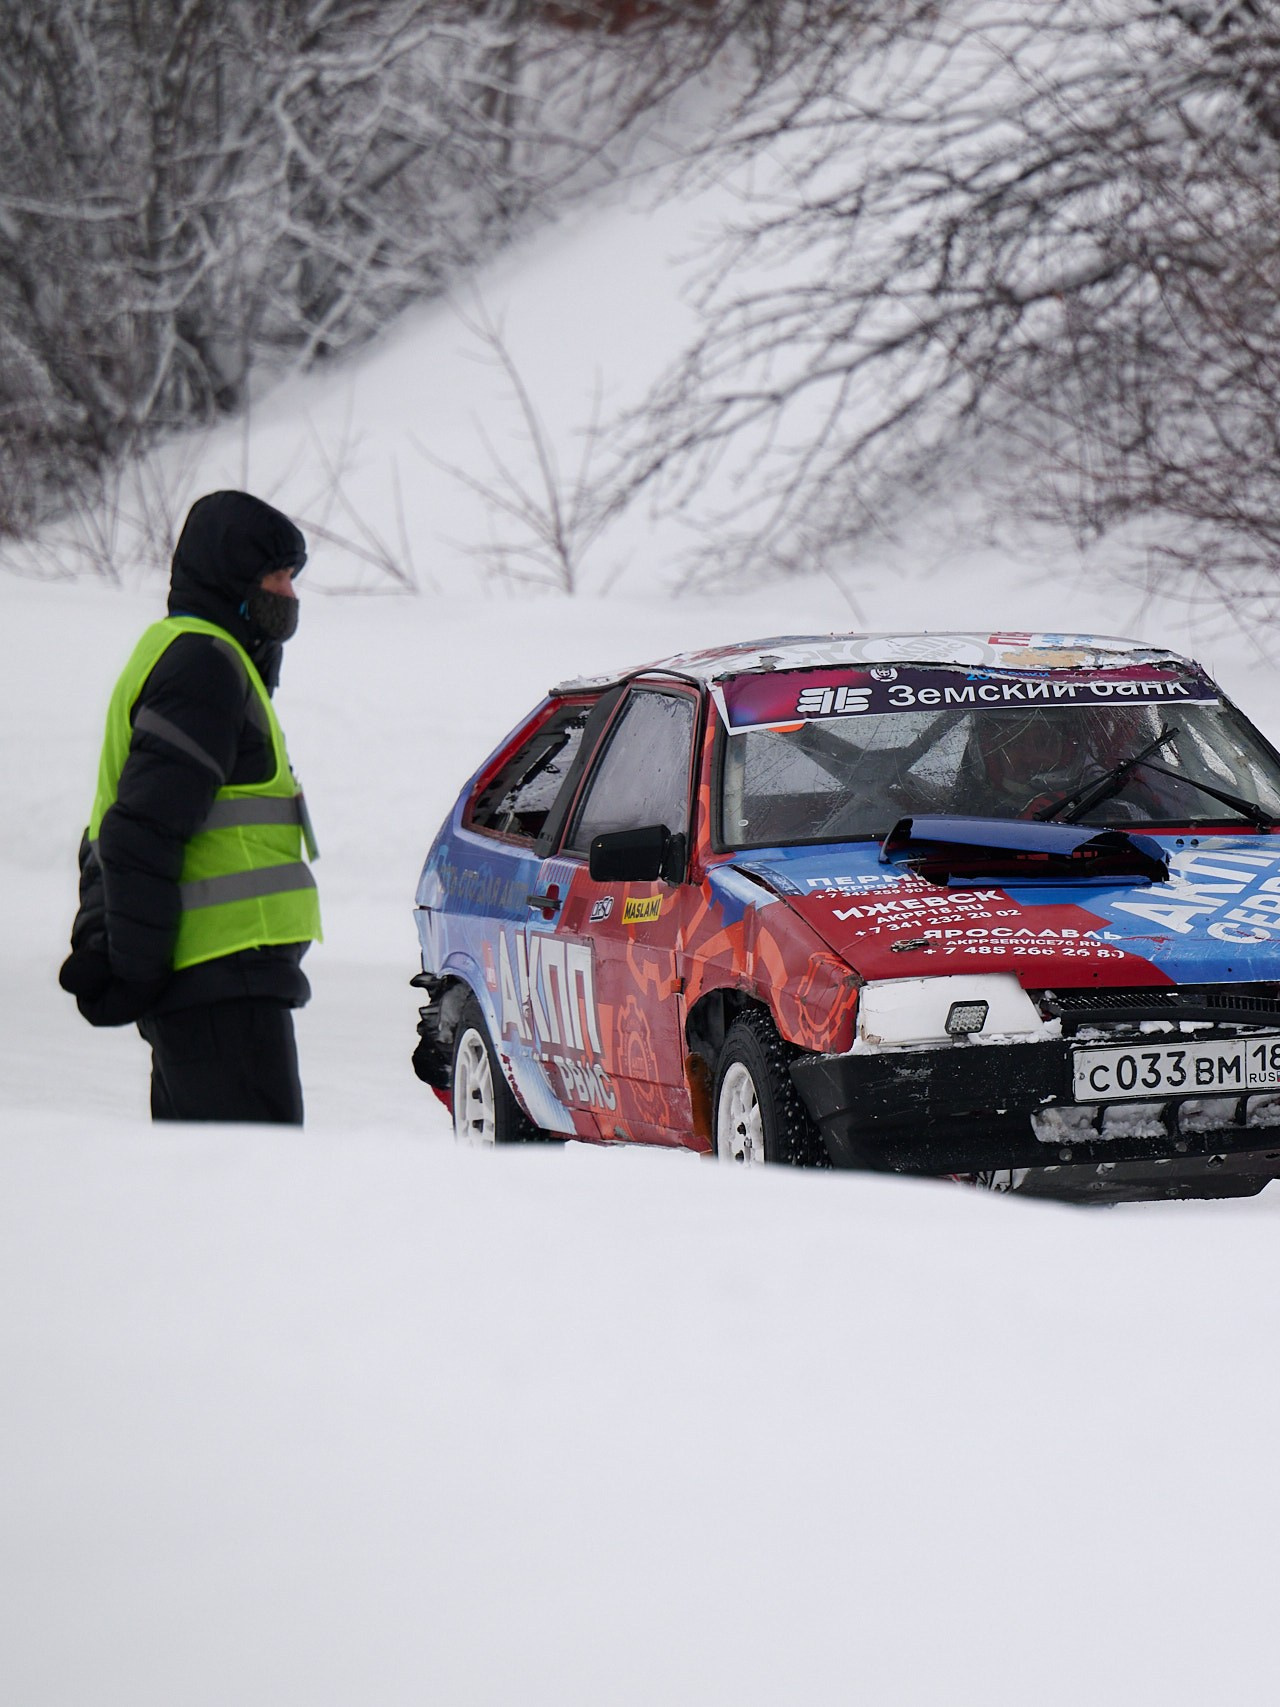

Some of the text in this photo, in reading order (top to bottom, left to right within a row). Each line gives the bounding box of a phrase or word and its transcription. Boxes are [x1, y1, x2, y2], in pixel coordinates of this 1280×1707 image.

[888, 680, 1190, 707] Земский банк
[825, 882, 932, 893] AKPP59.RU
[624, 898, 662, 920] MASLAMI
[832, 890, 1005, 921] ИЖЕВСК
[877, 904, 985, 924] AKPP18.RU
[887, 920, 923, 931] 341
[927, 915, 966, 926] 232
[967, 911, 993, 920] 20
[996, 909, 1022, 917] 02
[923, 928, 1123, 940] ЯРОСЛАВЛЬ
[946, 938, 1101, 947] AKPPSERVICE76.RU
[964, 946, 1007, 954] 485
[1013, 947, 1056, 956] 266
[1062, 948, 1091, 957] 26
[500, 931, 602, 1054] АКПП
[1249, 1071, 1276, 1084] RUS
